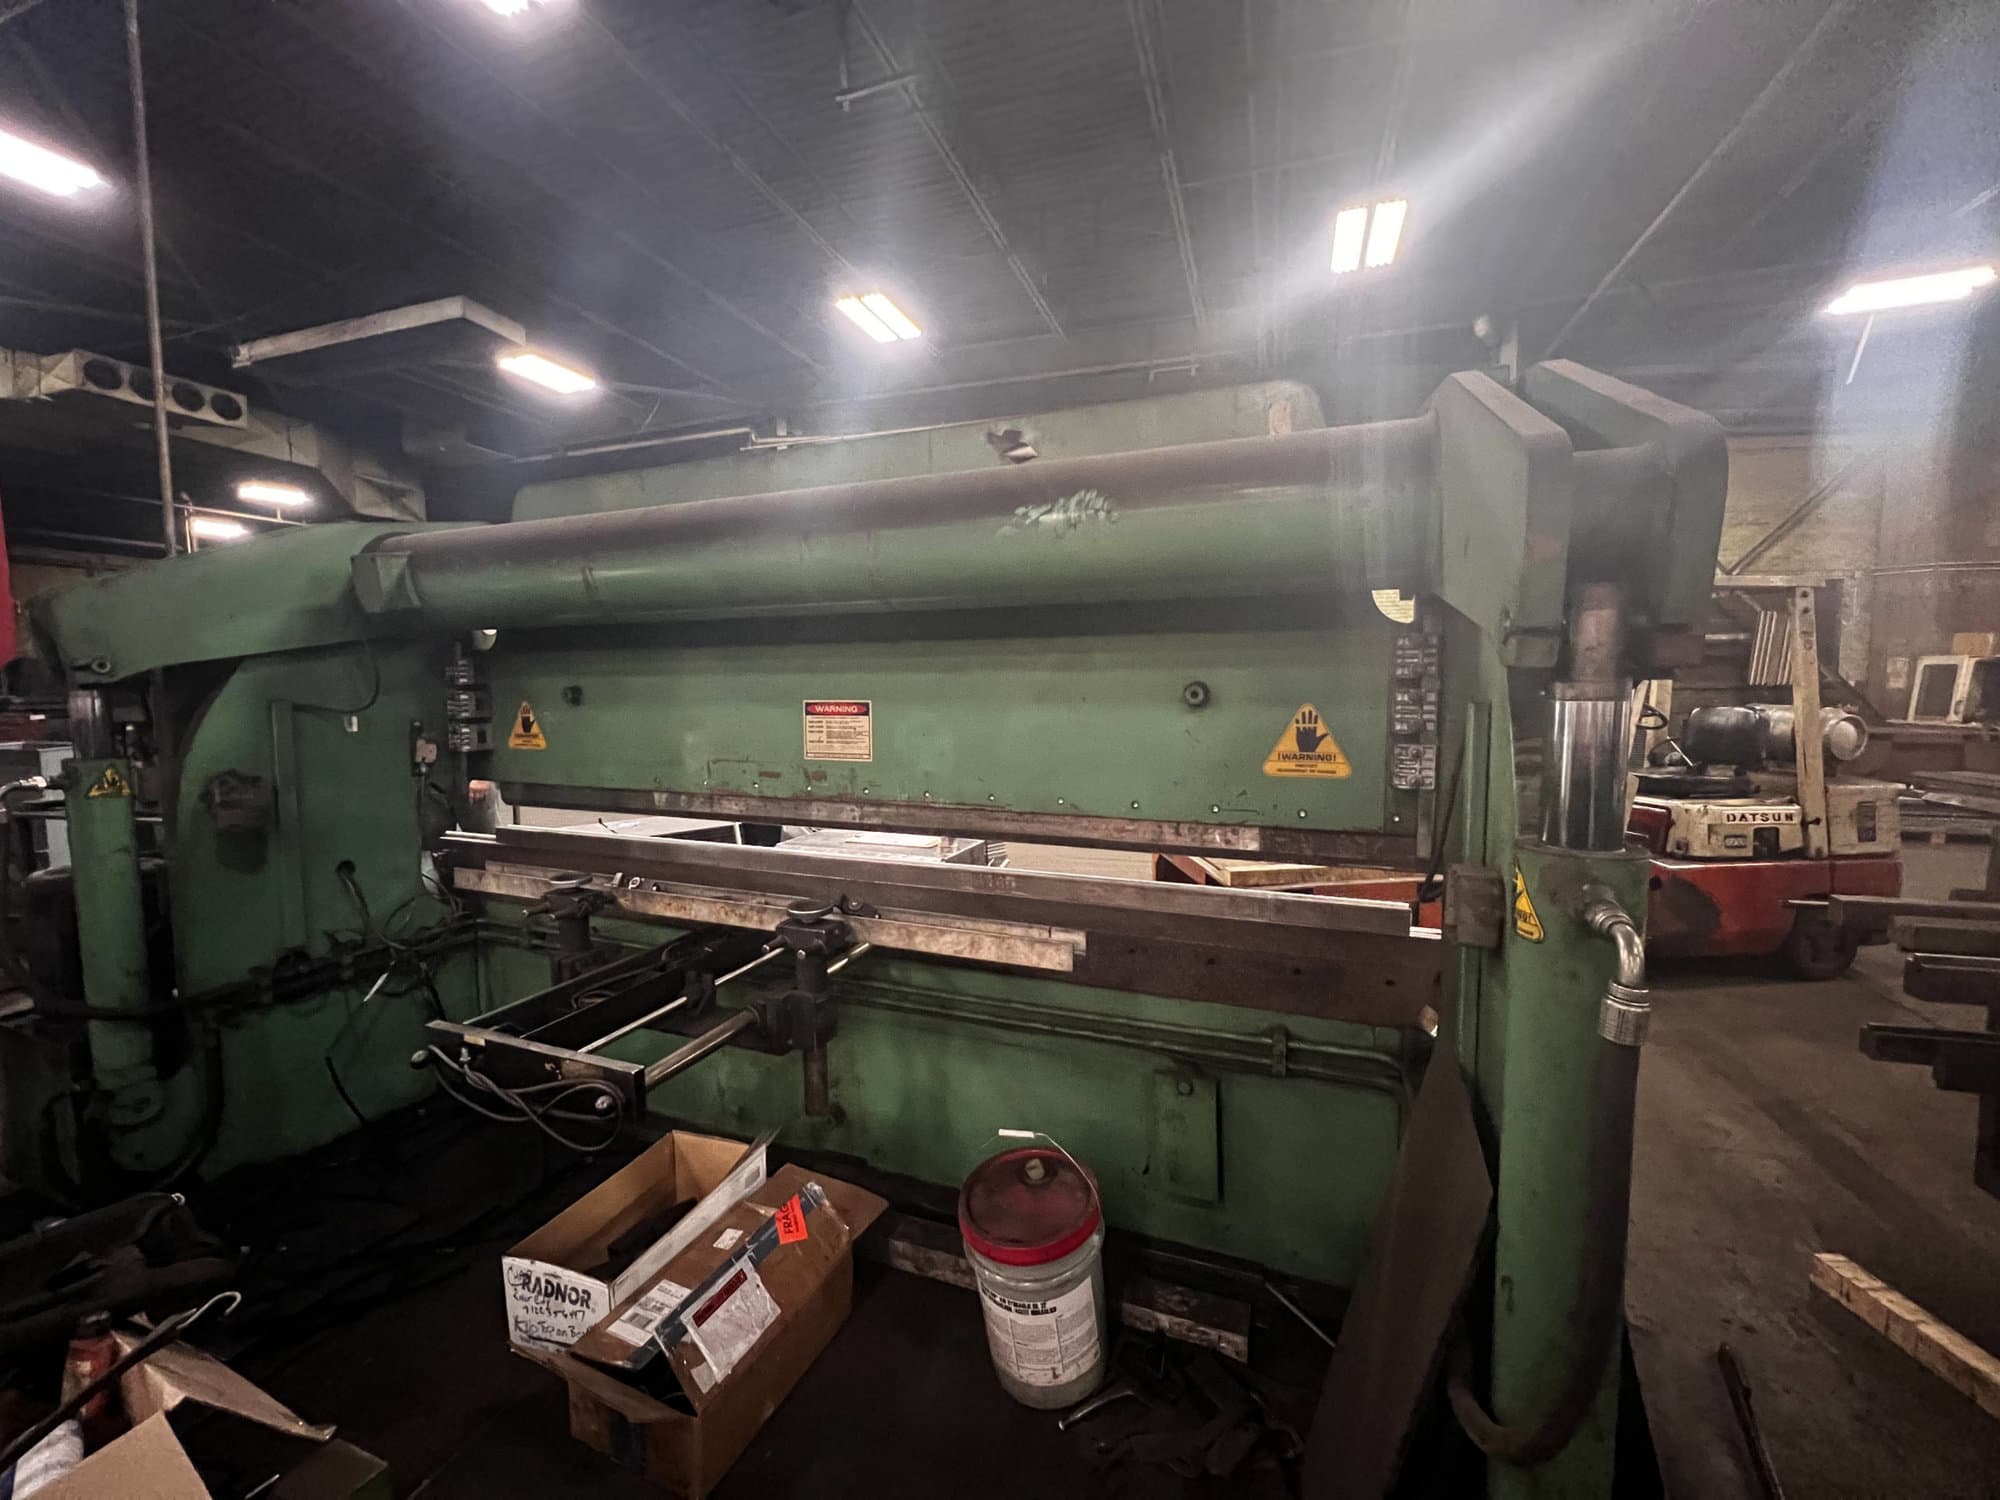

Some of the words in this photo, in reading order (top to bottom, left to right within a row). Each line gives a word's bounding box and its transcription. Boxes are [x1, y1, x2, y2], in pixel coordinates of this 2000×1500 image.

[815, 704, 858, 713] WARNING
[1726, 812, 1794, 822] DATSUN
[520, 1273, 592, 1310] RADNOR
